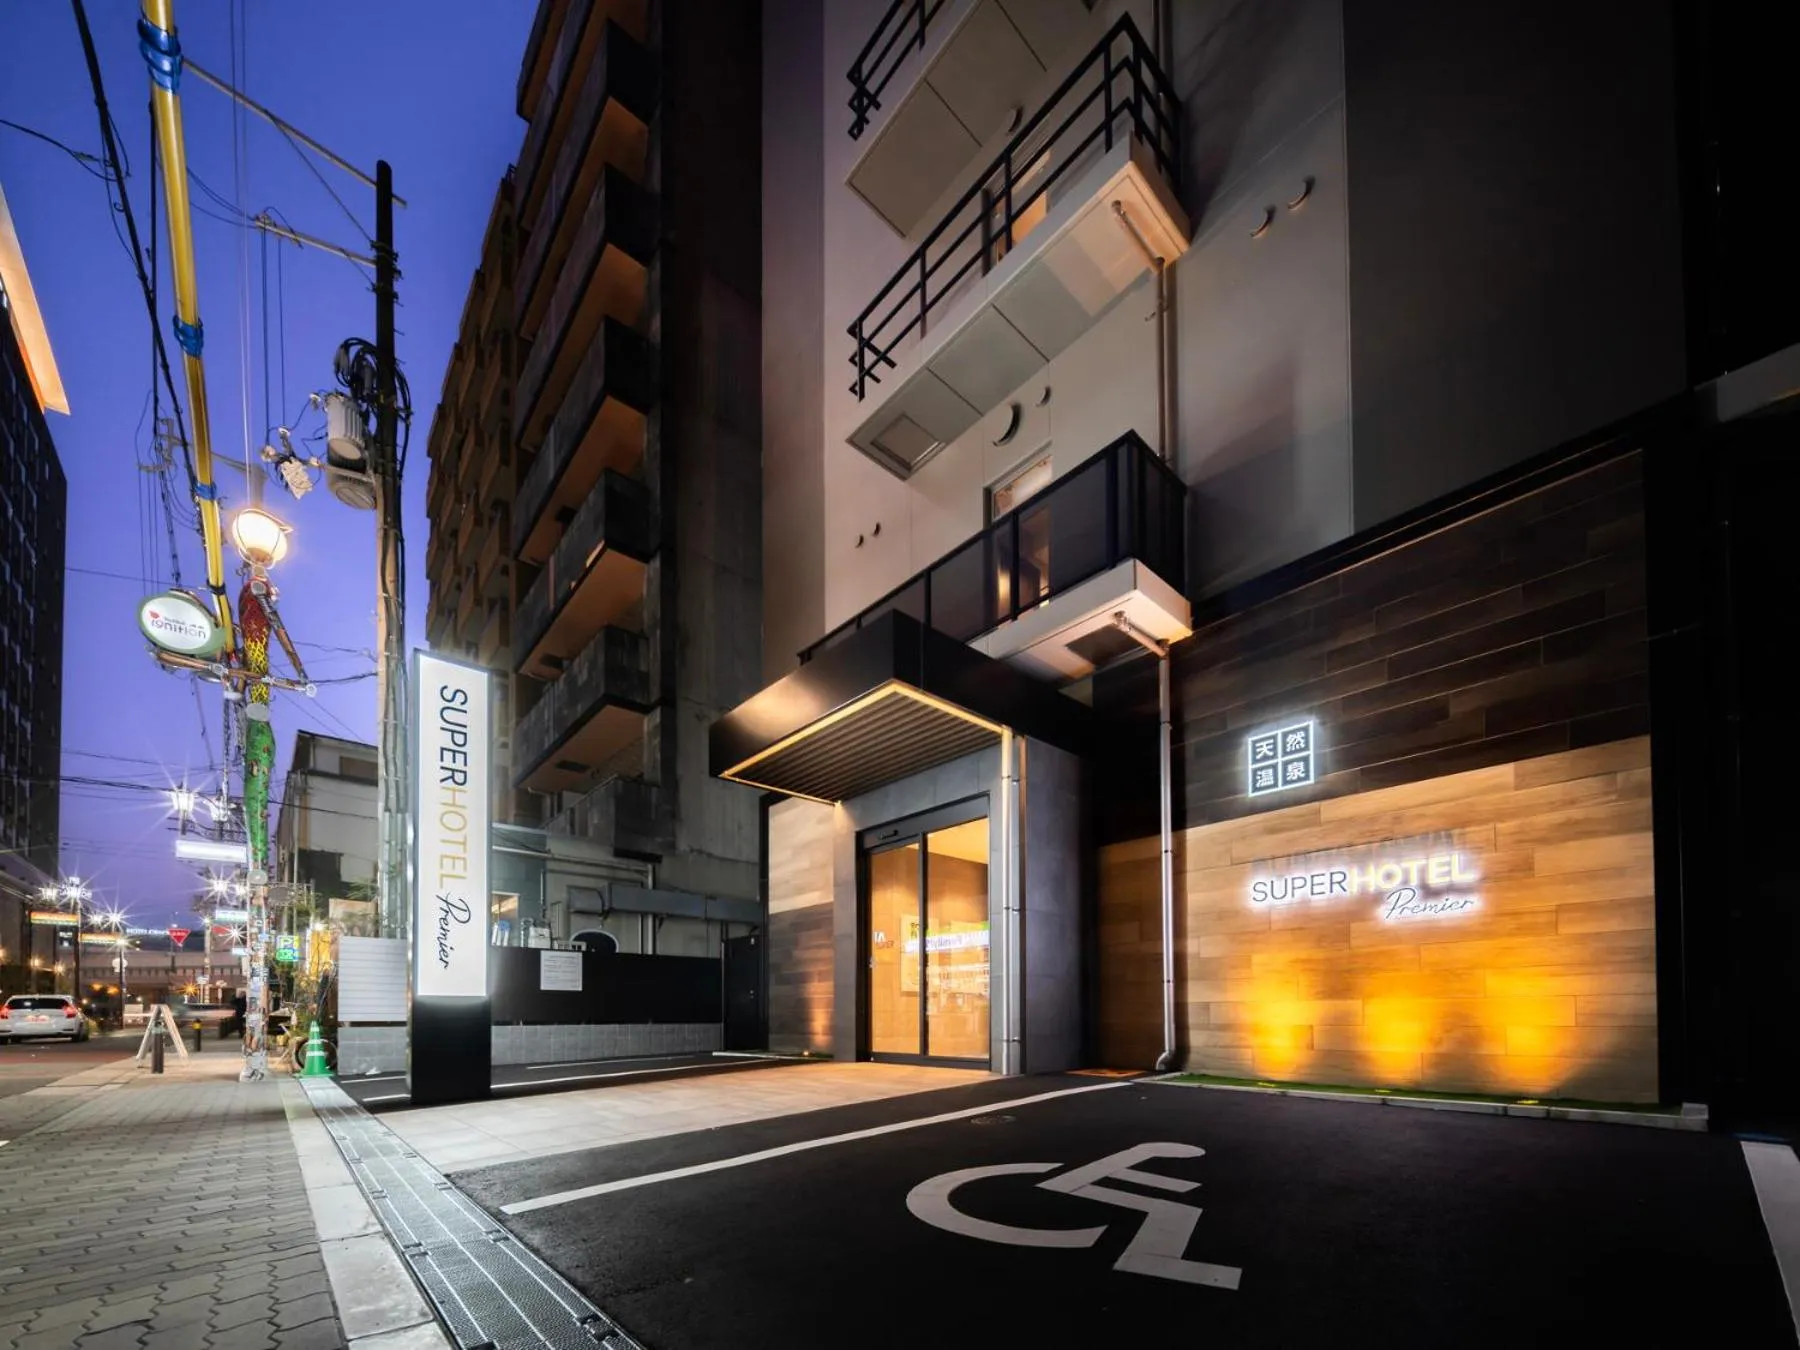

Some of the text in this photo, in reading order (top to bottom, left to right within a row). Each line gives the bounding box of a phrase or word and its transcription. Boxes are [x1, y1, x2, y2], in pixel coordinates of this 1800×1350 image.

[1255, 731, 1305, 760] 天然
[1255, 762, 1305, 788] 温泉
[1384, 887, 1475, 919] Premier
[436, 891, 471, 971] Premier
